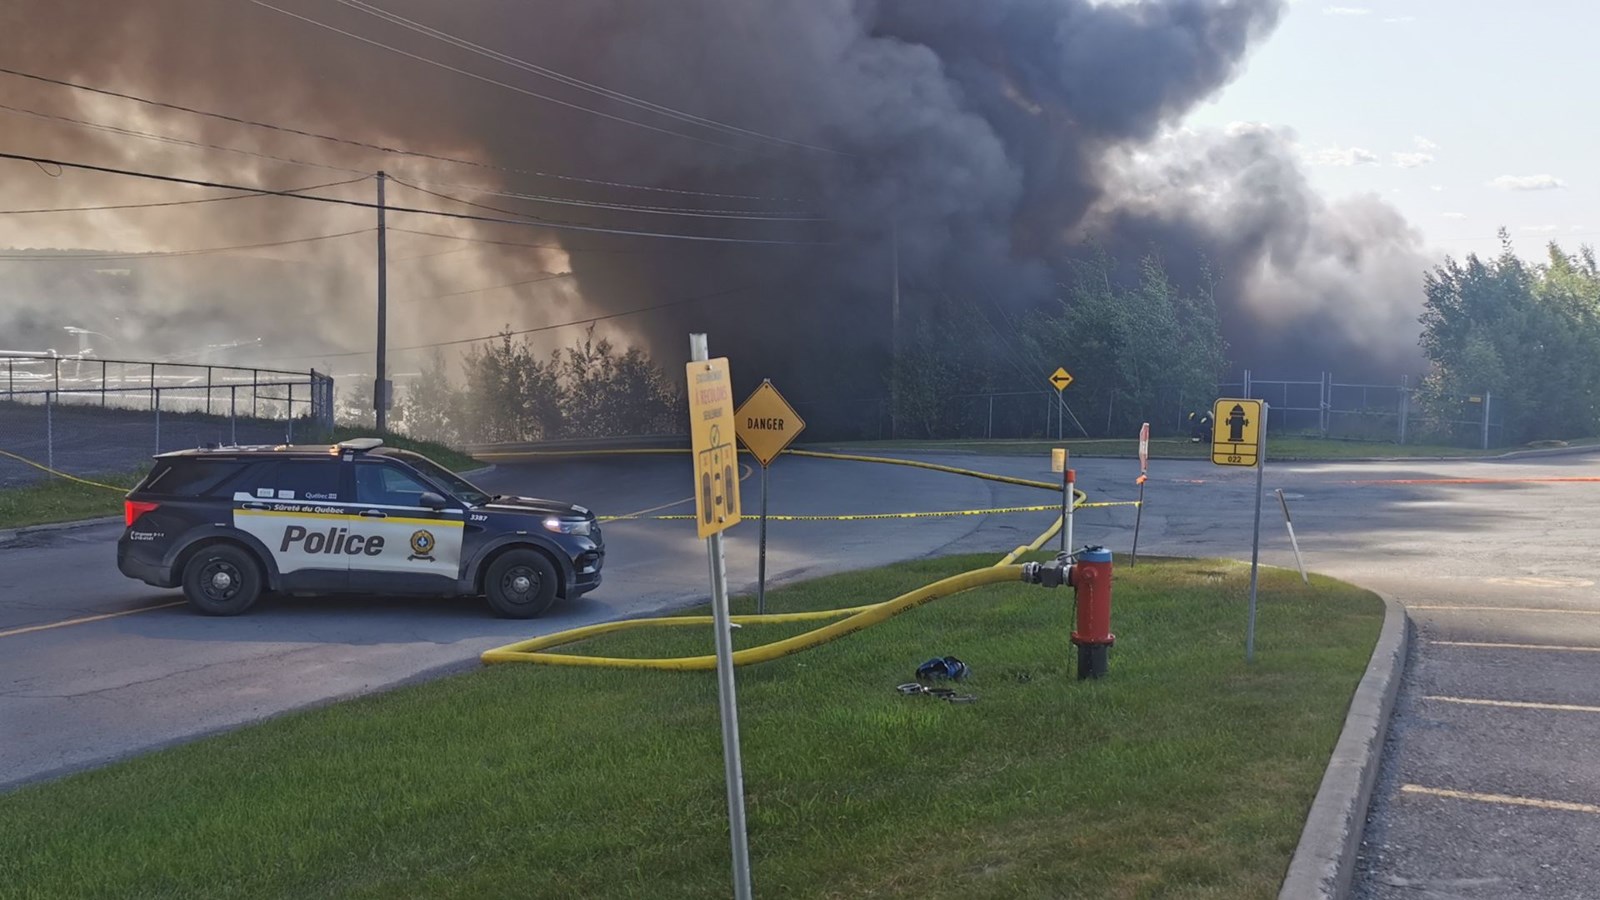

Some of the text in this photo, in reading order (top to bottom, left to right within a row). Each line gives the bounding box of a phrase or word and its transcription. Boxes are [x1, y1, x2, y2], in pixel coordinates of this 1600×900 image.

[747, 417, 784, 431] DANGER
[1227, 455, 1242, 463] 022
[305, 491, 328, 500] Québec
[273, 503, 344, 515] Sûreté du Québec
[470, 514, 488, 522] 3387
[280, 525, 385, 557] Police
